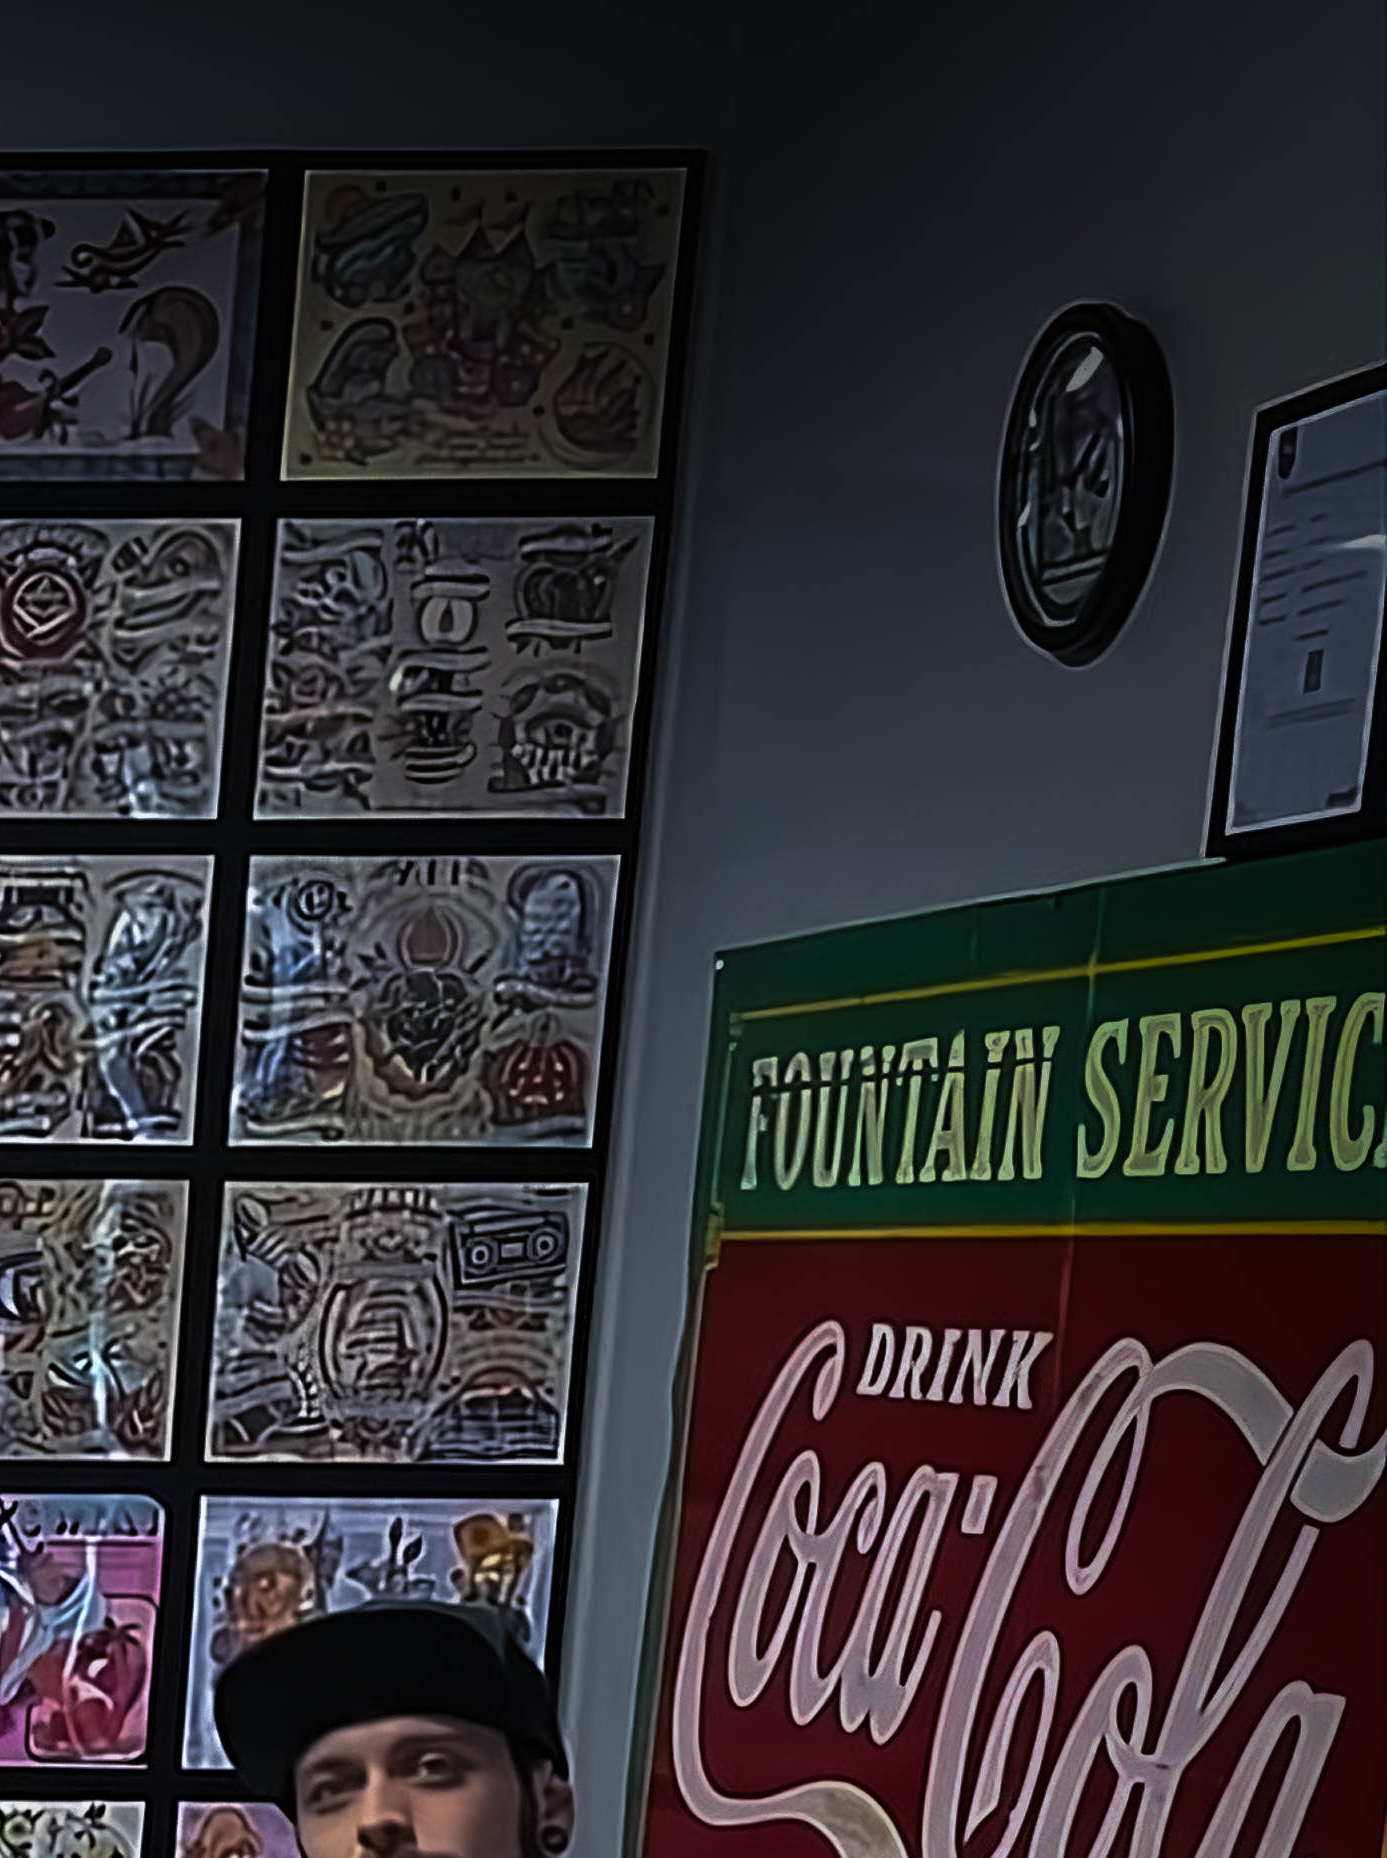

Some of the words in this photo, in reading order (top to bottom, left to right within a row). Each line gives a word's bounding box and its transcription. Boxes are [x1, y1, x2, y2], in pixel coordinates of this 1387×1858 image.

[740, 1025, 1061, 1190] FOUNTAIN
[1076, 991, 1387, 1179] SERVIC
[856, 1321, 1055, 1410] DRINK
